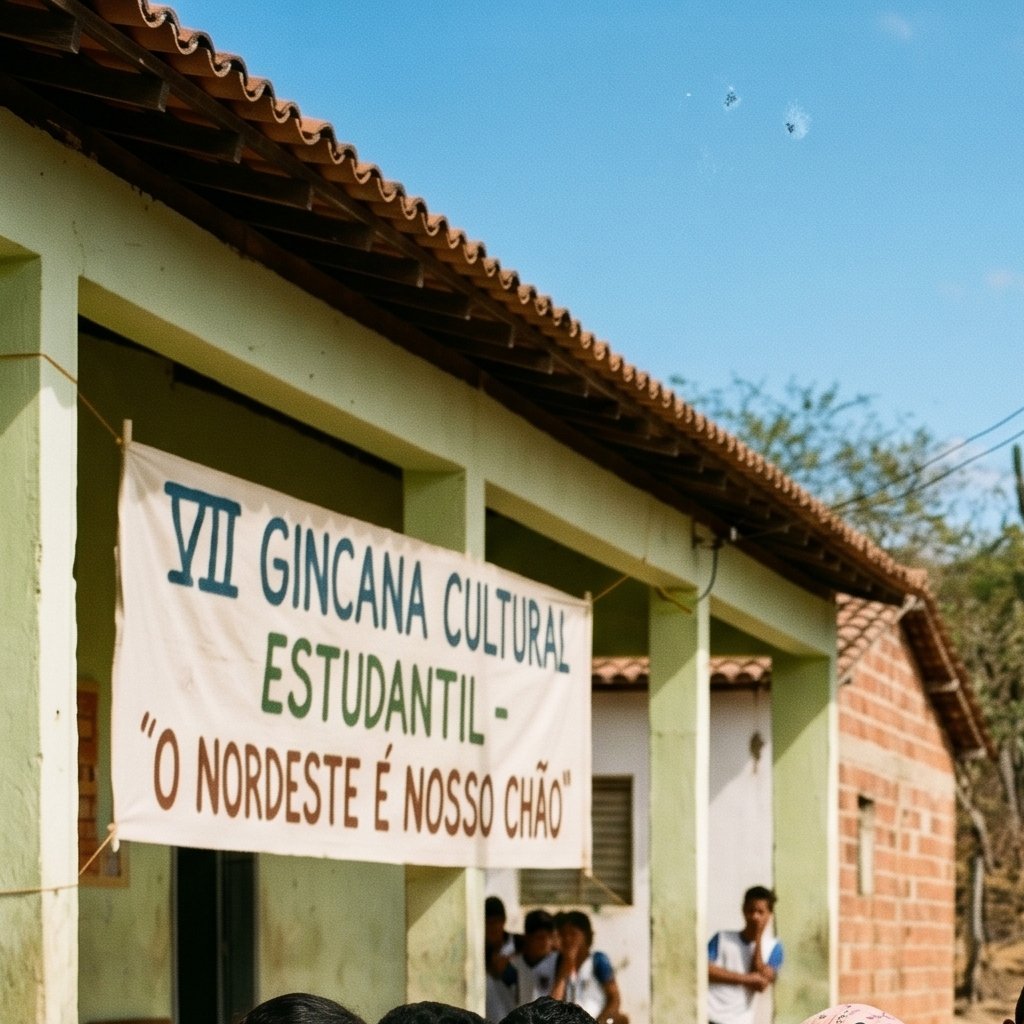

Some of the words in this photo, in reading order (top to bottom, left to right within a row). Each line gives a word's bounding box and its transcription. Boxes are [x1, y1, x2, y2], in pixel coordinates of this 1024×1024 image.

[164, 481, 241, 599] VII
[260, 516, 428, 640] GINCANA
[443, 572, 570, 674] CULTURAL
[261, 632, 485, 746] ESTUDANTIL
[196, 736, 361, 829] NORDESTE
[374, 743, 393, 832] É
[403, 765, 494, 838] NOSSO
[504, 760, 572, 839] CHÃO"
